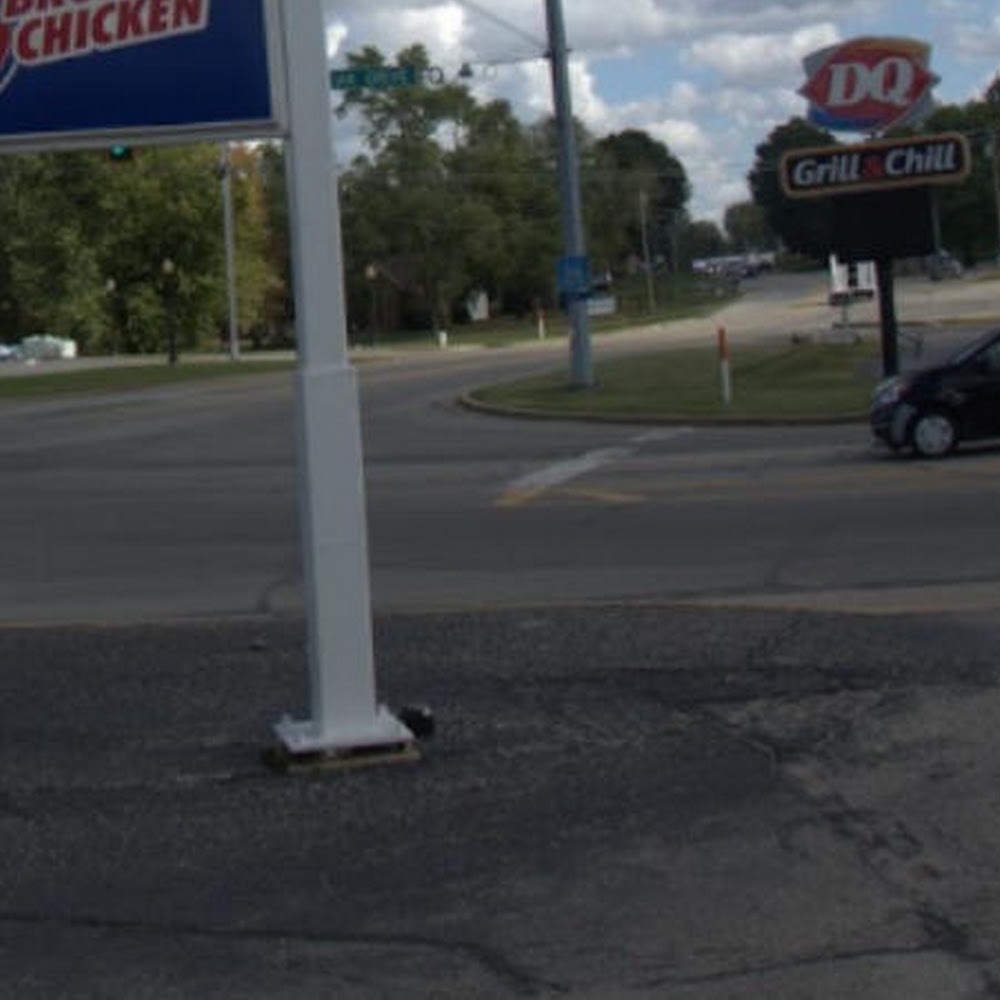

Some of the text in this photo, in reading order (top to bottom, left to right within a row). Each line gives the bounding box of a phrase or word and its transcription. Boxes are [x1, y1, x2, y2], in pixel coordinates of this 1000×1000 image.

[826, 56, 914, 107] DQ
[792, 152, 859, 185] Grill
[884, 143, 955, 175] Chill
